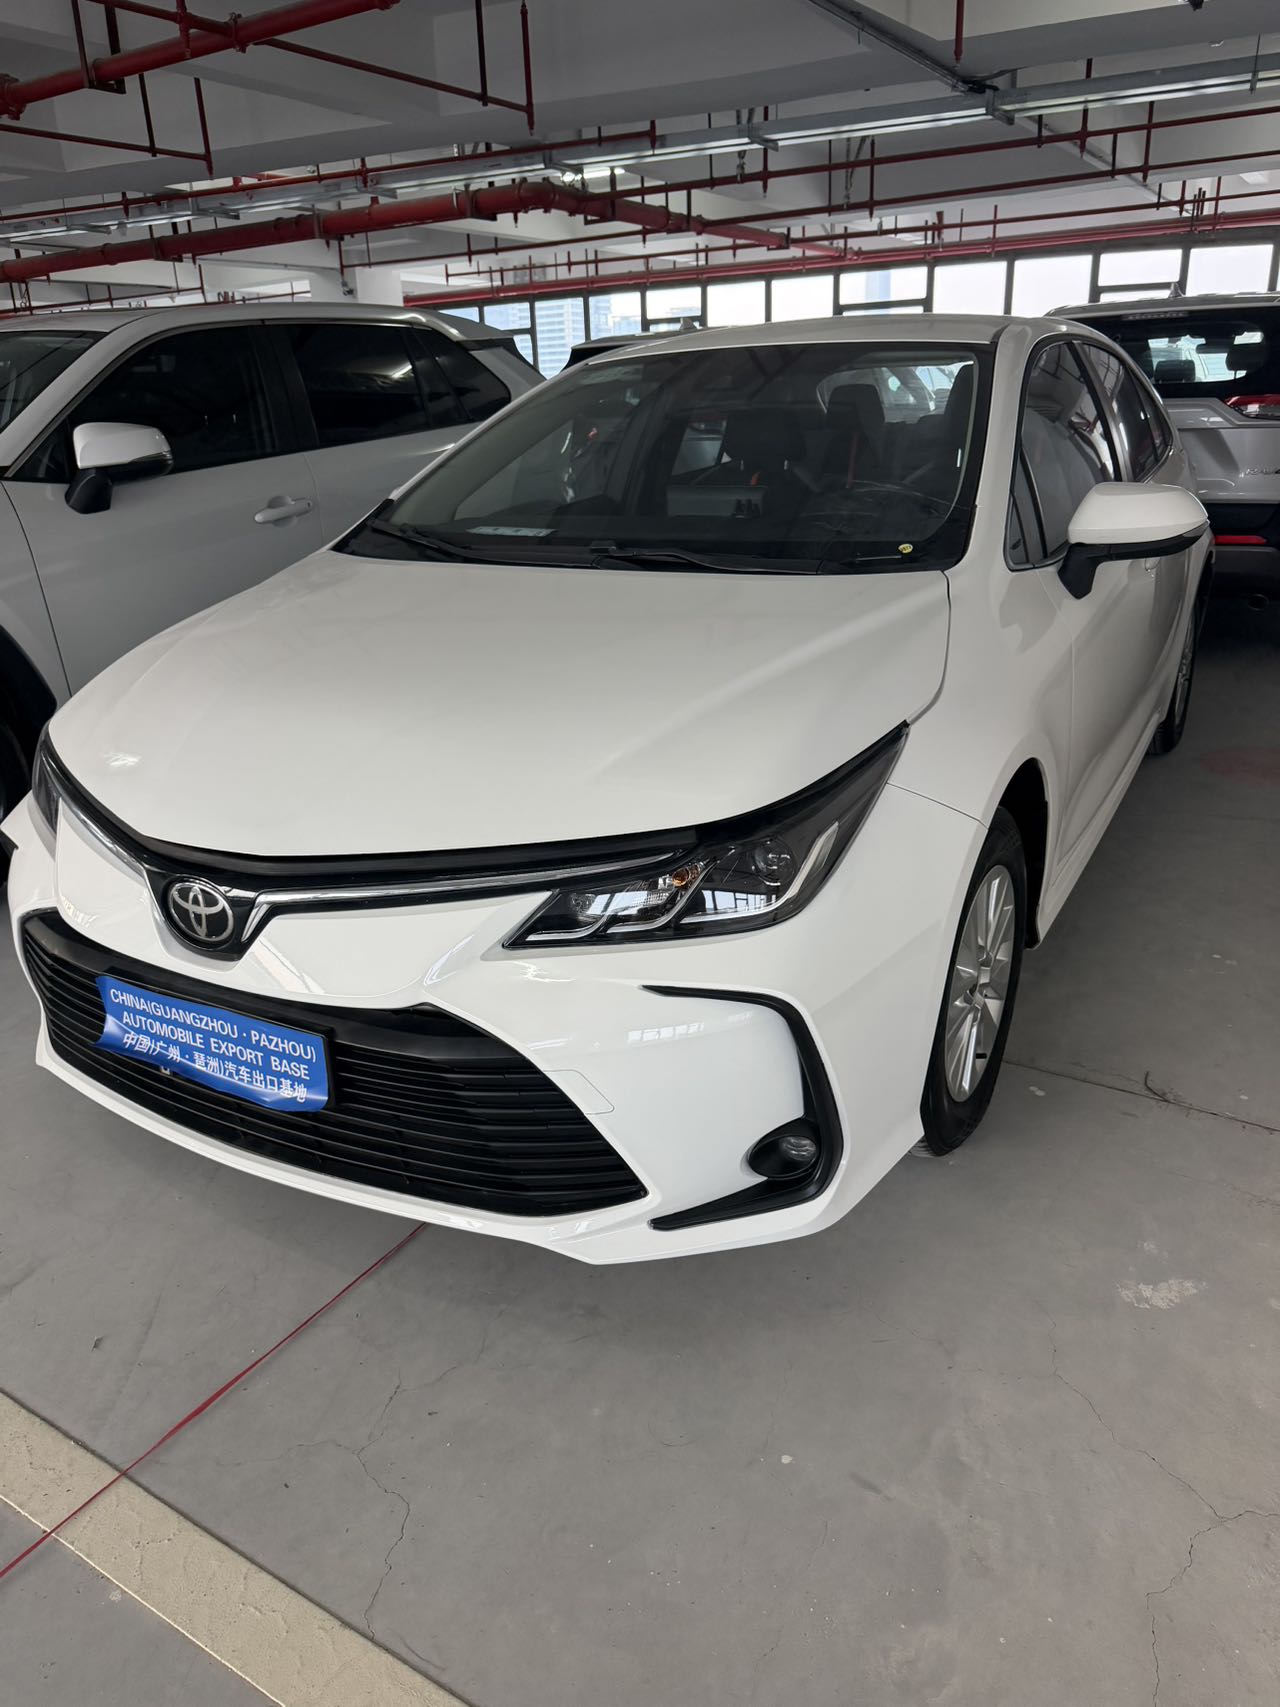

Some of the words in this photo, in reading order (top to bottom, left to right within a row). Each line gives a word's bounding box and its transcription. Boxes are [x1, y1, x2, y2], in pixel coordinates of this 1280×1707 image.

[123, 1011, 205, 1049] AUTOMOBILE
[210, 1037, 264, 1067] EXPORT
[270, 1056, 310, 1081] BASE
[250, 1030, 316, 1063] PAZHOU)
